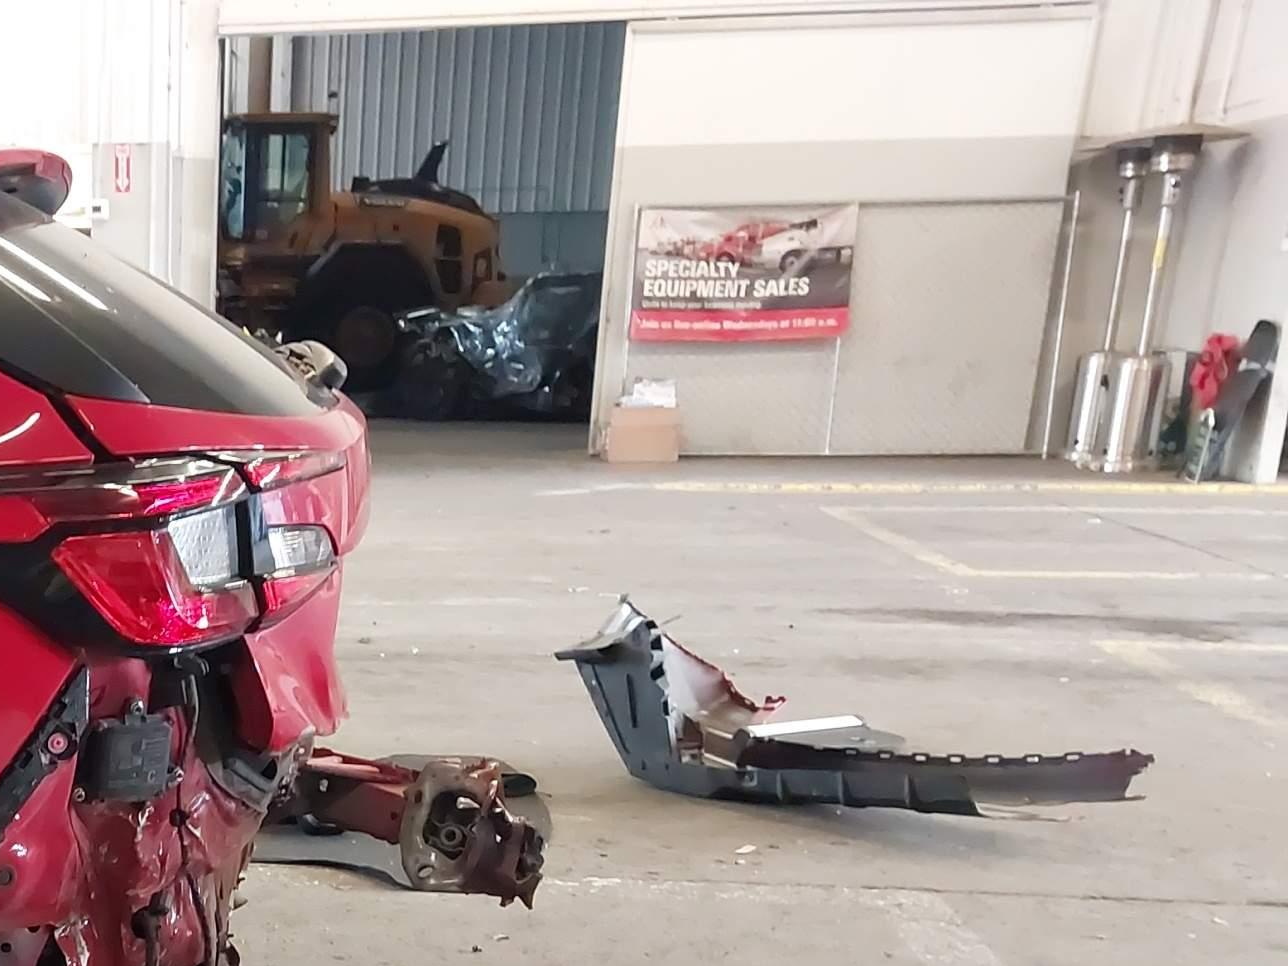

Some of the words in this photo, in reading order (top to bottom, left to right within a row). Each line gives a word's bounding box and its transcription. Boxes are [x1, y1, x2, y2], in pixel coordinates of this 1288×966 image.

[645, 259, 740, 278] SPECIALTY
[643, 279, 750, 298] EQUIPMENT
[753, 277, 810, 297] SALES
